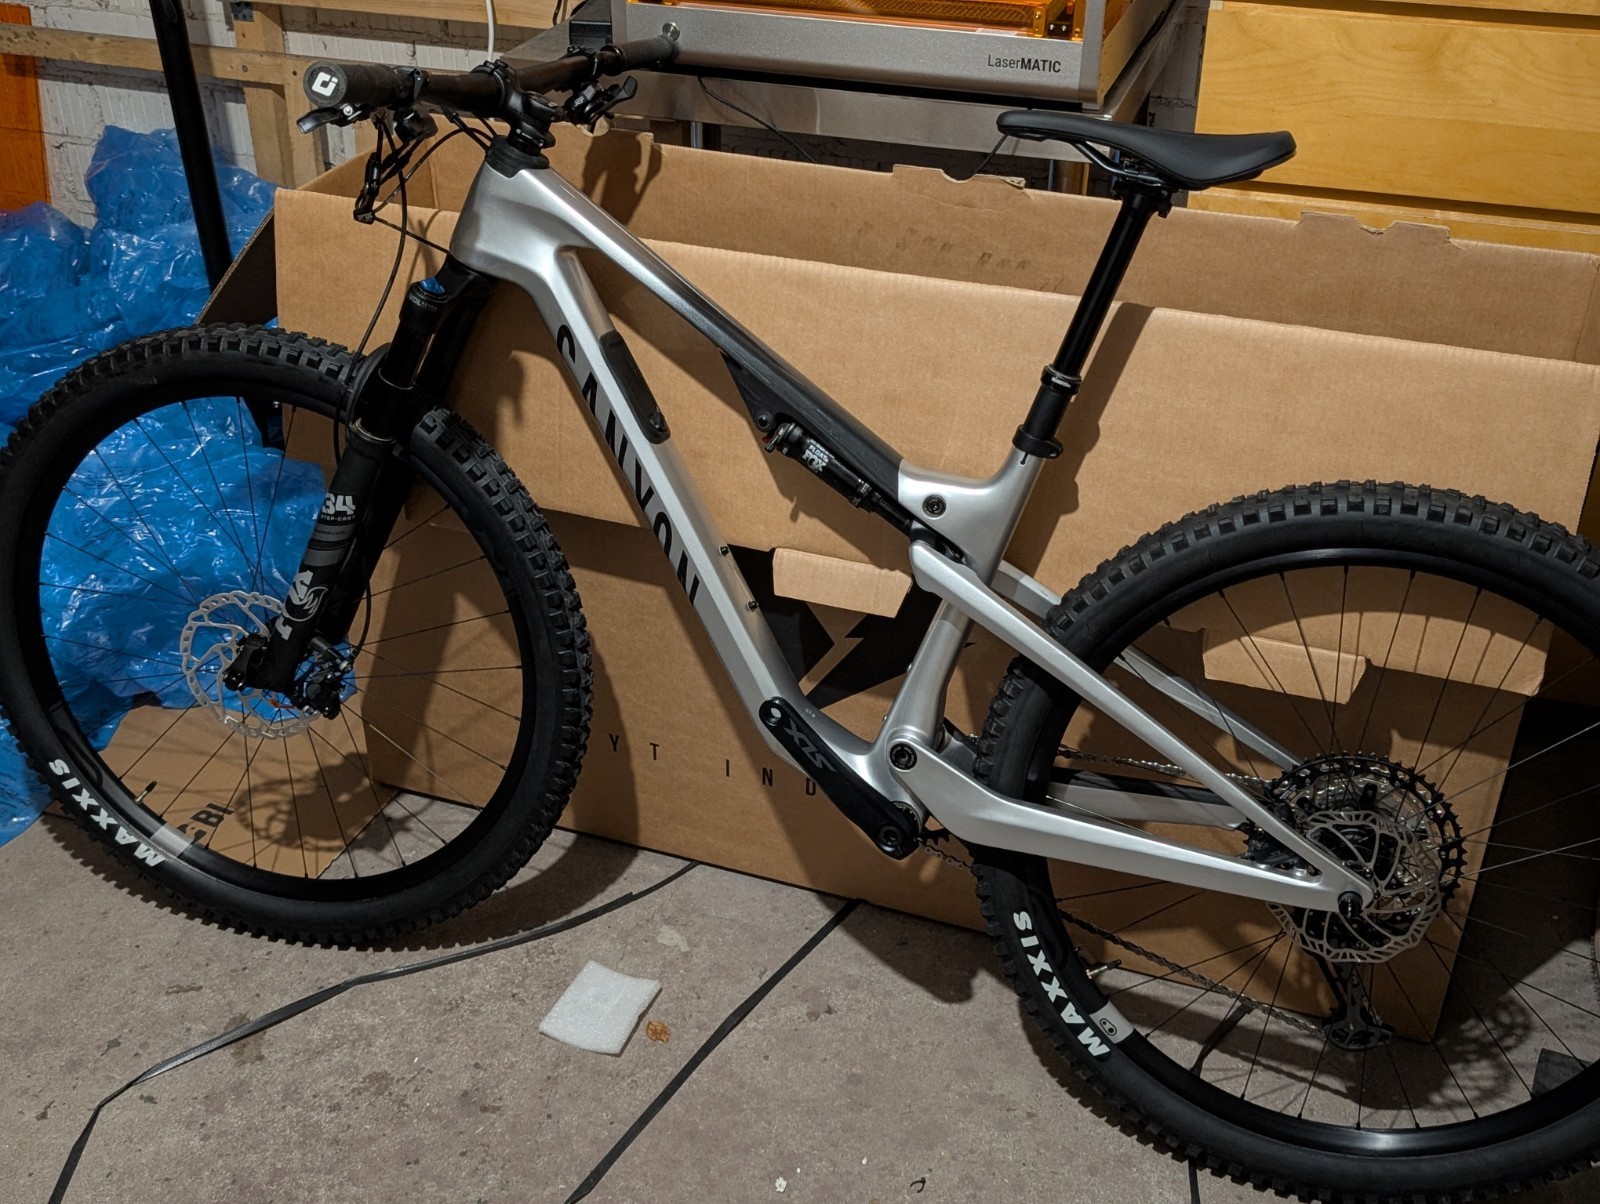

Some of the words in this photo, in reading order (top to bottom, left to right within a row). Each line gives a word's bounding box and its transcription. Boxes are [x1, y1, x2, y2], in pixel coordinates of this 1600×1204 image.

[987, 54, 1062, 74] LaserMATIC
[556, 324, 700, 606] CANYON
[802, 449, 827, 472] FOX
[321, 491, 356, 515] 34
[784, 717, 838, 774] SLX
[49, 759, 166, 868] MAXXIS
[1013, 910, 1111, 1057] MAXXIS
